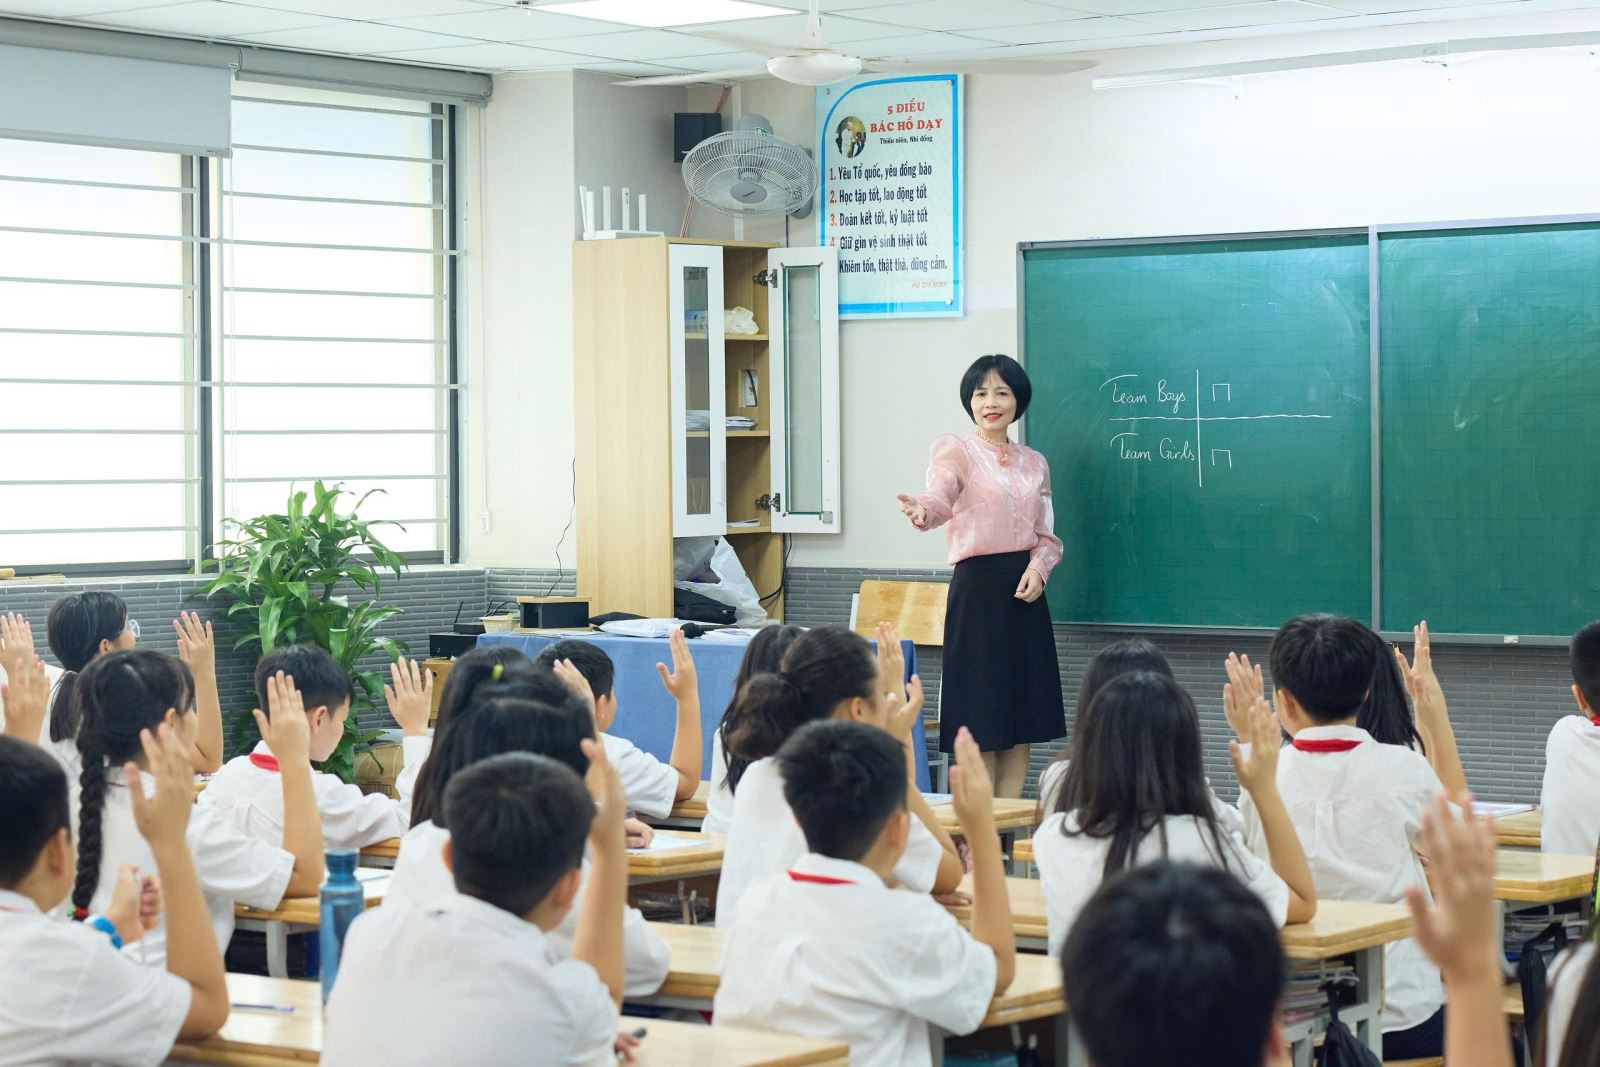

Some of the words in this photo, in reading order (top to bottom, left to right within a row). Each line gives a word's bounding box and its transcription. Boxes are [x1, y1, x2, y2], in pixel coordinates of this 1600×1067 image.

[887, 105, 894, 115] 5
[896, 97, 925, 113] ĐIỀU
[870, 119, 894, 132] BÁC
[897, 115, 914, 131] HỒ
[917, 118, 943, 131] DẠY
[829, 167, 836, 180] 1.
[838, 166, 852, 180] Yêu
[853, 162, 863, 179] Tổ
[864, 162, 883, 181] quốc,
[884, 163, 898, 180] yêu
[899, 160, 917, 178] đồng
[918, 161, 933, 175] bào
[829, 189, 837, 203] 2.
[839, 189, 853, 205] Học
[854, 188, 867, 205] tập
[868, 185, 882, 203] tốt,
[883, 187, 895, 201] lao
[896, 186, 914, 203] động
[916, 184, 928, 199] tốt
[830, 212, 838, 227] 3.
[839, 212, 858, 226] Đoàn
[860, 209, 872, 225] kết
[874, 209, 888, 226] tốt,
[889, 208, 899, 226] kỷ
[900, 209, 915, 226] luật
[917, 206, 928, 223] tốt
[840, 235, 854, 250] Giữ
[854, 234, 867, 251] gìn
[868, 235, 878, 251] vệ
[879, 233, 896, 248] sinh
[898, 231, 914, 250] thật
[916, 230, 928, 247] tốt
[839, 257, 861, 274] Khiêm
[862, 256, 877, 275] tốn,
[878, 256, 893, 275] thật
[894, 256, 909, 272] thà,
[910, 256, 928, 273] dũng
[930, 254, 948, 270] cảm.
[1099, 374, 1148, 404] Team
[1110, 432, 1152, 462] Team
[1159, 437, 1195, 461] Girls
